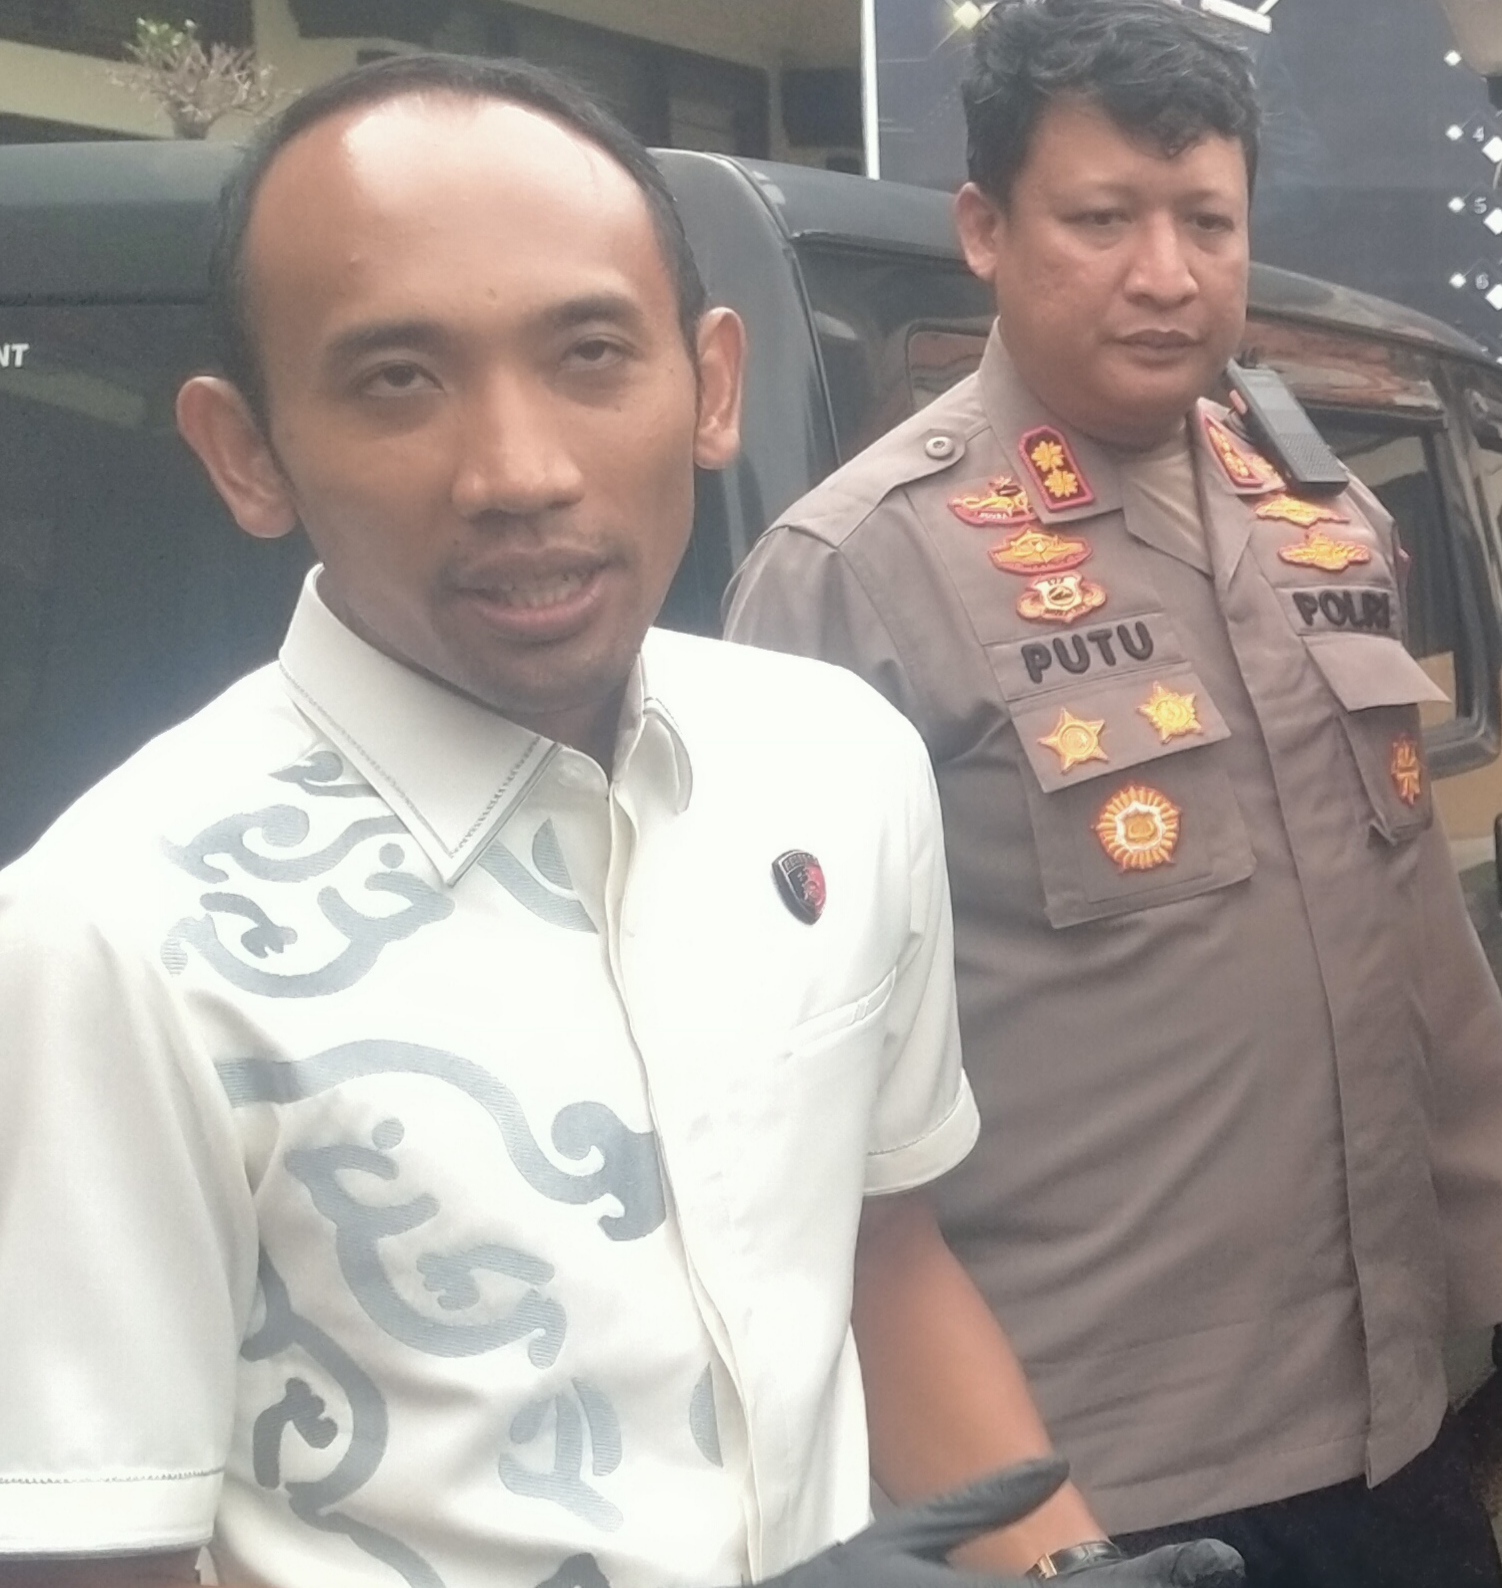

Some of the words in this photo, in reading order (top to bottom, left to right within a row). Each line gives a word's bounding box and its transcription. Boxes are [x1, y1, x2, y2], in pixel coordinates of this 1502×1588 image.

[1472, 126, 1485, 143] 4
[1473, 197, 1488, 215] 5
[1474, 272, 1490, 291] 6
[1291, 589, 1391, 629] POLRI
[1020, 620, 1154, 685] PUTU
